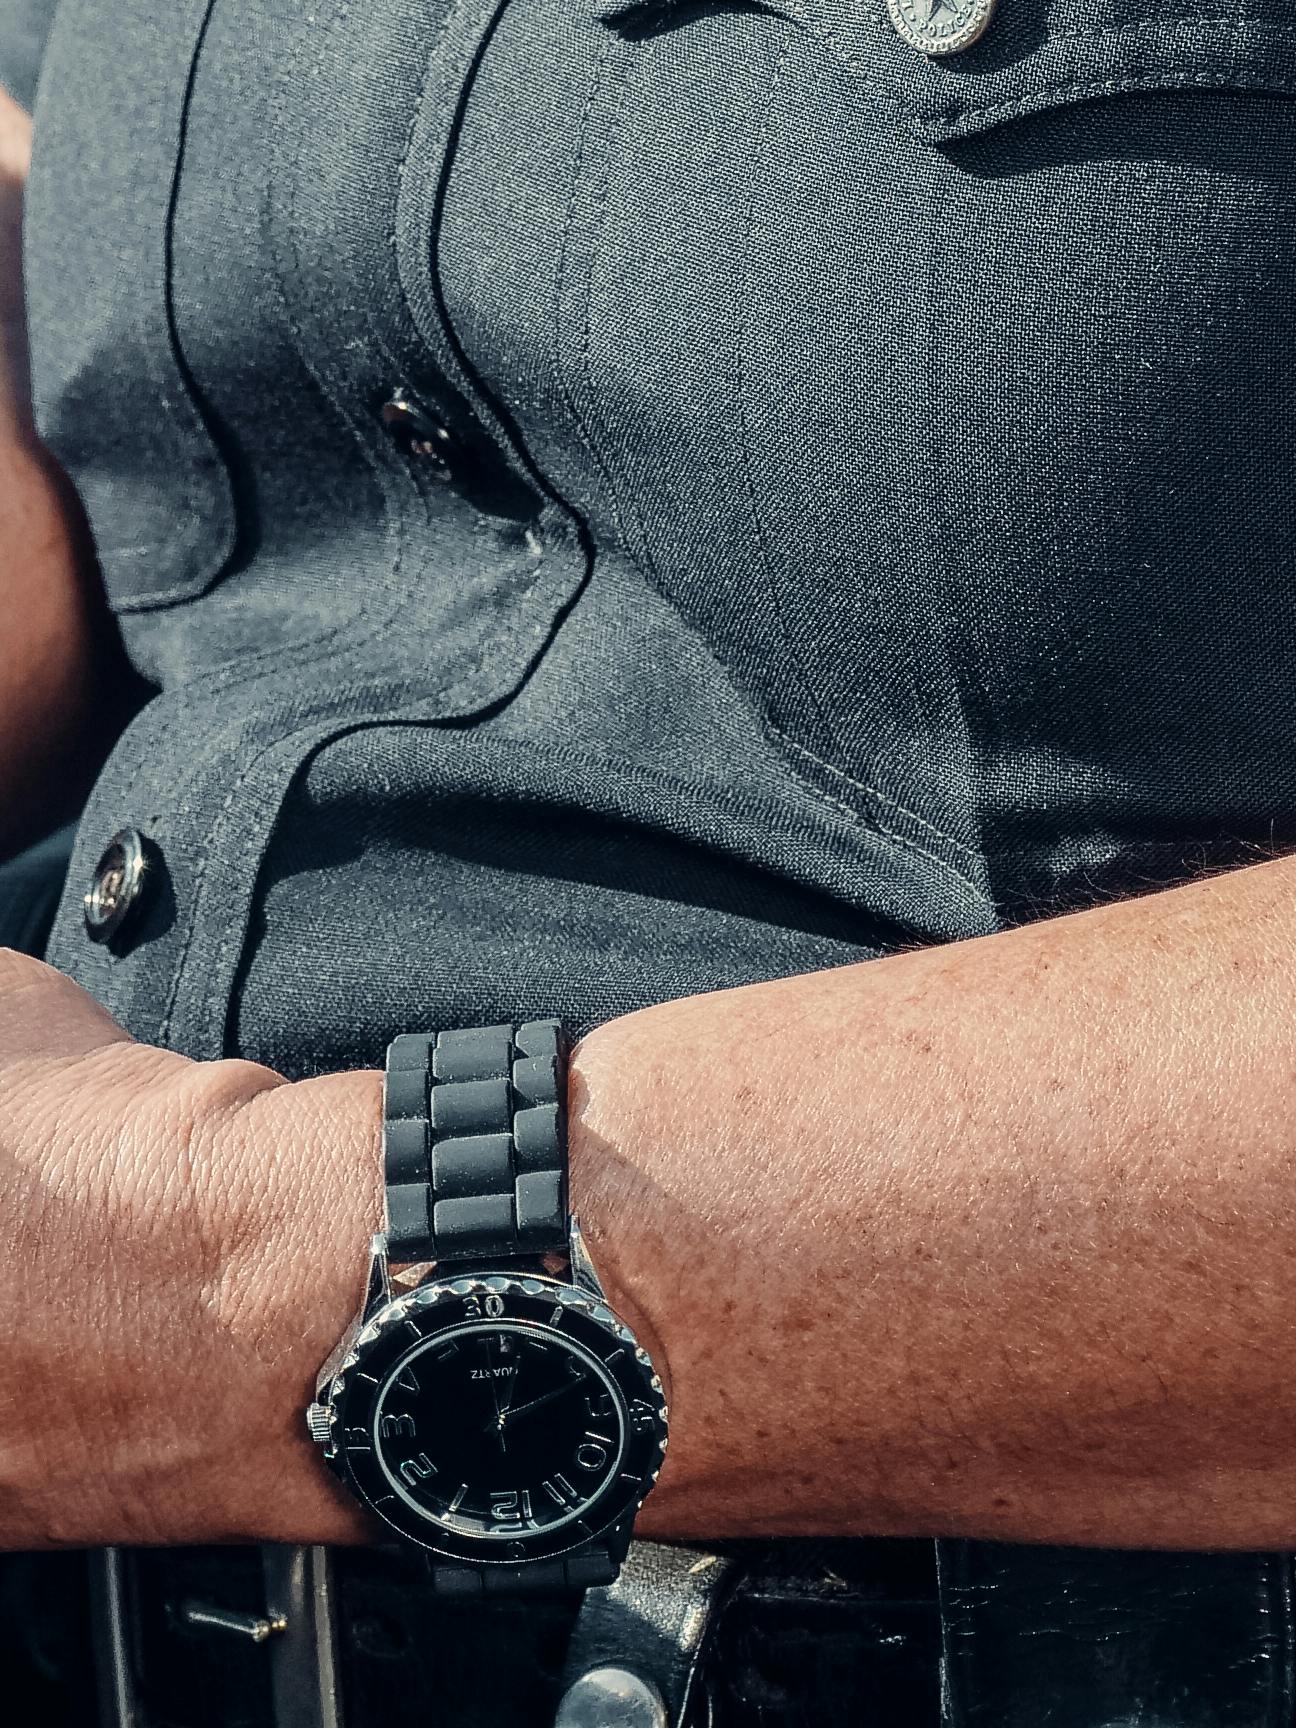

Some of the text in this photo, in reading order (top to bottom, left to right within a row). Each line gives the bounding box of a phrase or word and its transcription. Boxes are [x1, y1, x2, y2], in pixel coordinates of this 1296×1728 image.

[918, 5, 973, 37] POLICE
[463, 1295, 505, 1318] 30
[468, 1367, 519, 1380] QUARTZ
[381, 1412, 417, 1438] 3
[575, 1430, 615, 1473] 10
[399, 1452, 439, 1487] 2
[489, 1489, 533, 1521] 12
[542, 1472, 578, 1508] 11
